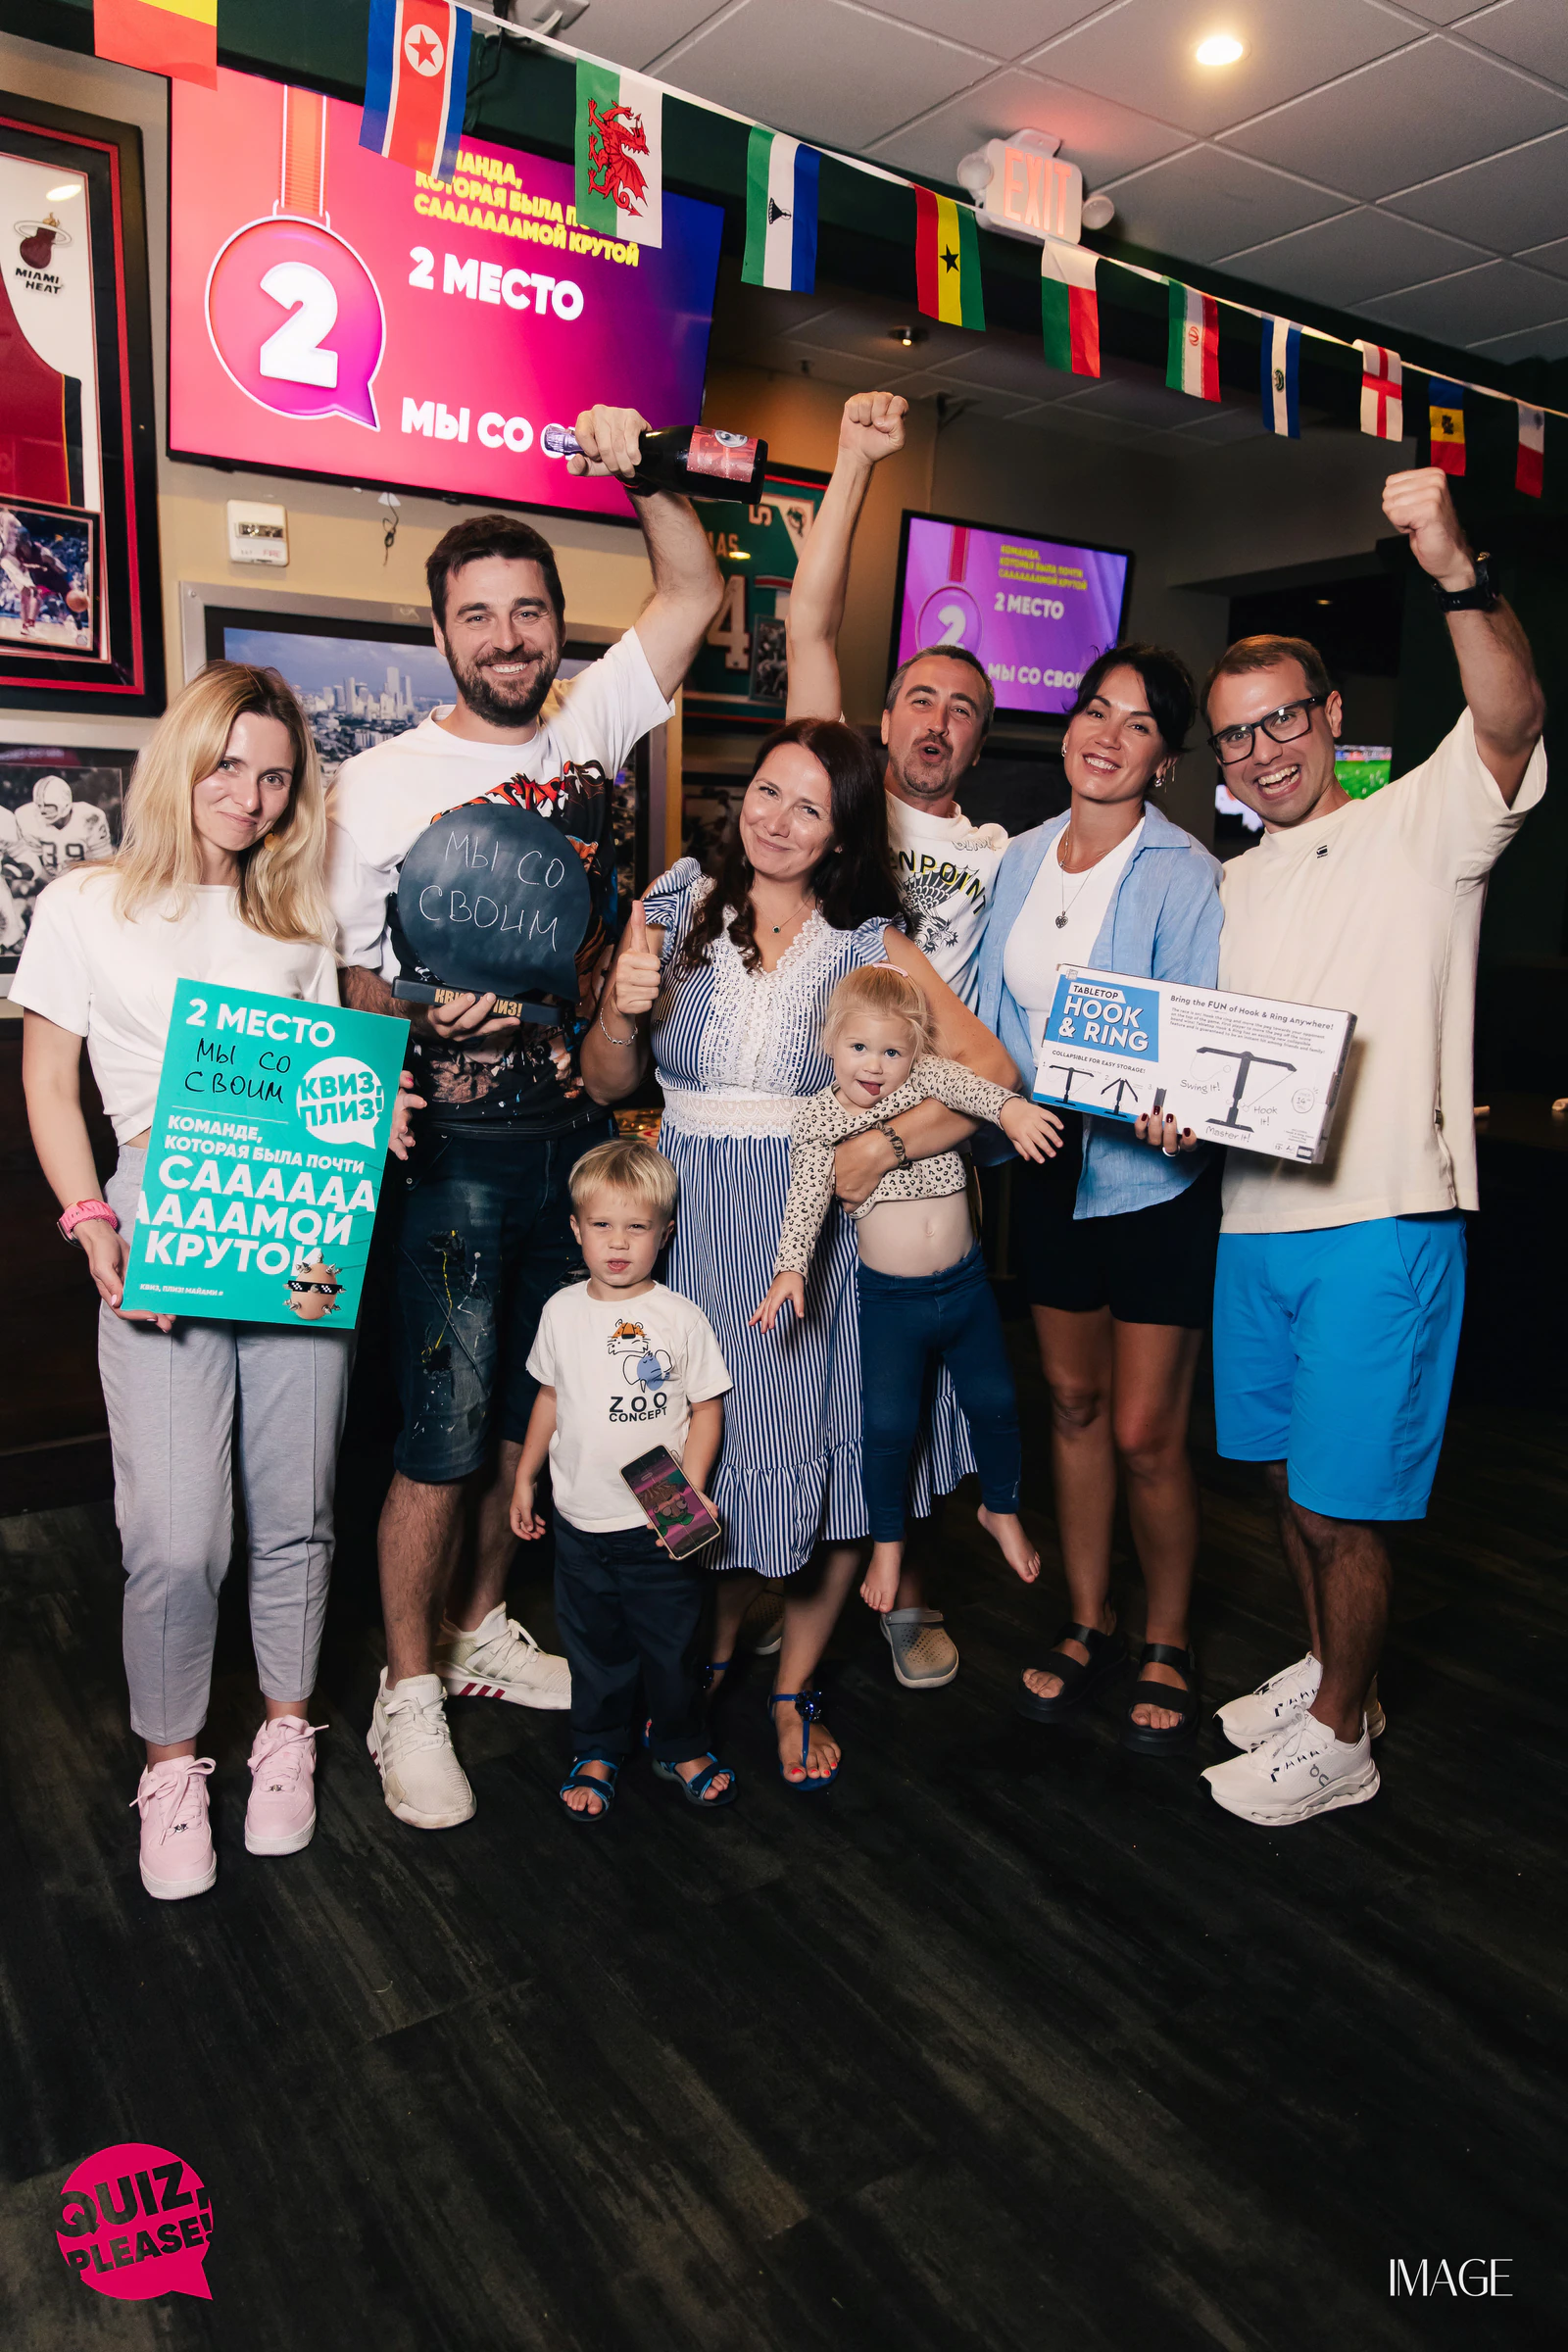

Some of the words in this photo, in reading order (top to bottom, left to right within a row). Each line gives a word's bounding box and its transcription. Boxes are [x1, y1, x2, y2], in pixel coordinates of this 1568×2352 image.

[456, 149, 522, 190] АНДА,
[510, 190, 564, 223] БЫЛА
[1004, 147, 1072, 237] EXIT
[569, 231, 639, 268] КРУТОЙ
[15, 268, 60, 284] MIAMI
[25, 280, 61, 295] HEAT
[409, 246, 434, 290] 2
[443, 253, 584, 321] МЕСТО
[259, 262, 338, 388] 2
[401, 397, 470, 443] МЫ
[477, 412, 534, 453] СО
[994, 591, 1004, 612] 2
[1007, 593, 1064, 620] МЕСТО
[938, 605, 966, 649] 2
[988, 662, 1015, 682] МЫ
[1017, 665, 1041, 685] СО
[1043, 668, 1084, 689] СВО
[445, 831, 499, 871] МЫ
[517, 850, 564, 888] СО
[889, 848, 986, 915] NPOINT
[419, 885, 558, 952] СВОИМ
[1074, 985, 1118, 1000] TABLETOP
[185, 998, 208, 1027] 2
[216, 1003, 336, 1048] МЕСТО
[1063, 995, 1144, 1029] HOOK
[1170, 995, 1191, 1005] Bring
[1193, 999, 1205, 1007] the
[1207, 1001, 1227, 1010] FUN
[1239, 1007, 1259, 1017] Hook
[1269, 1012, 1288, 1023] Ring
[1289, 1017, 1334, 1030] Anywhere!
[1058, 1016, 1076, 1039] &
[1083, 1021, 1149, 1053] RING
[197, 1037, 236, 1065] МЫ
[259, 1051, 291, 1073] СО
[1052, 1050, 1088, 1062] COLLAPSIBLE
[1116, 1062, 1146, 1074] STORAGE!
[185, 1071, 284, 1103] СВОИМ
[301, 1071, 382, 1101] КВИЗ,
[1180, 1079, 1208, 1095] Swing
[1210, 1082, 1220, 1092] It!
[300, 1098, 382, 1127] ПЛИЗ!
[1253, 1105, 1278, 1114] Hook
[1260, 1116, 1270, 1126] It!
[168, 1115, 263, 1143] КОМАНДЕ,
[1205, 1126, 1239, 1140] Master
[1241, 1133, 1251, 1143] It!
[165, 1135, 250, 1159] КОТОРАЯ
[253, 1147, 303, 1167] БЫЛА
[306, 1154, 365, 1174] ПОЧТИ
[159, 1154, 375, 1212] САААААА
[144, 1230, 322, 1276] КРУТОЙ
[139, 1283, 162, 1293] КВИЗ,
[162, 1285, 184, 1294] ПЛИЗ!
[184, 1287, 218, 1296] МАЙАМИ
[609, 1406, 667, 1423] CONCEPT
